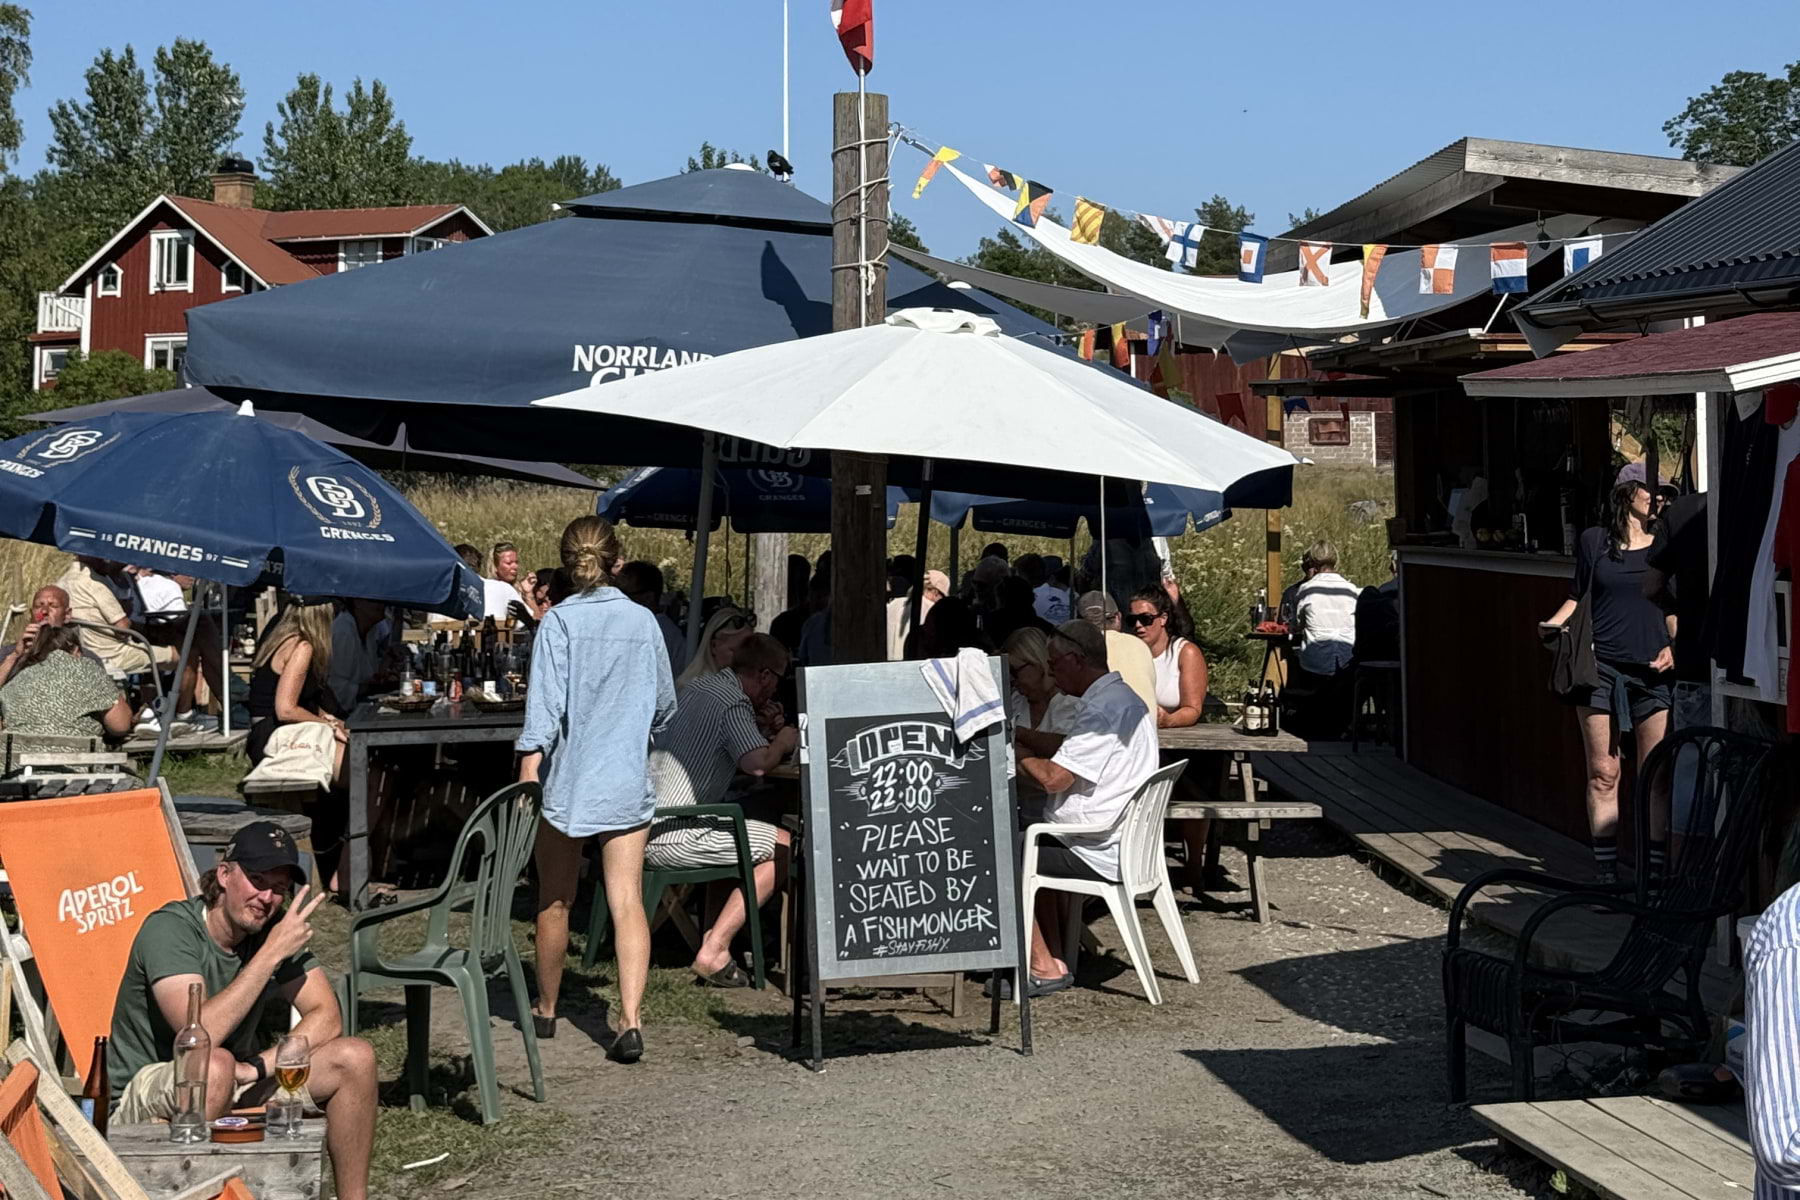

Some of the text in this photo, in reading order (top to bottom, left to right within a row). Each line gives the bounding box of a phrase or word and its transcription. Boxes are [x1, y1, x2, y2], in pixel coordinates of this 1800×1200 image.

[115, 533, 203, 563] GRÄNGES
[858, 724, 952, 763] OPEN
[872, 760, 933, 788] 12:00
[870, 785, 932, 811] 22:00
[915, 851, 940, 874] TO
[946, 848, 977, 871] BE
[58, 871, 144, 921] APEROL
[849, 875, 977, 913] SEATED BY
[845, 924, 857, 947] A
